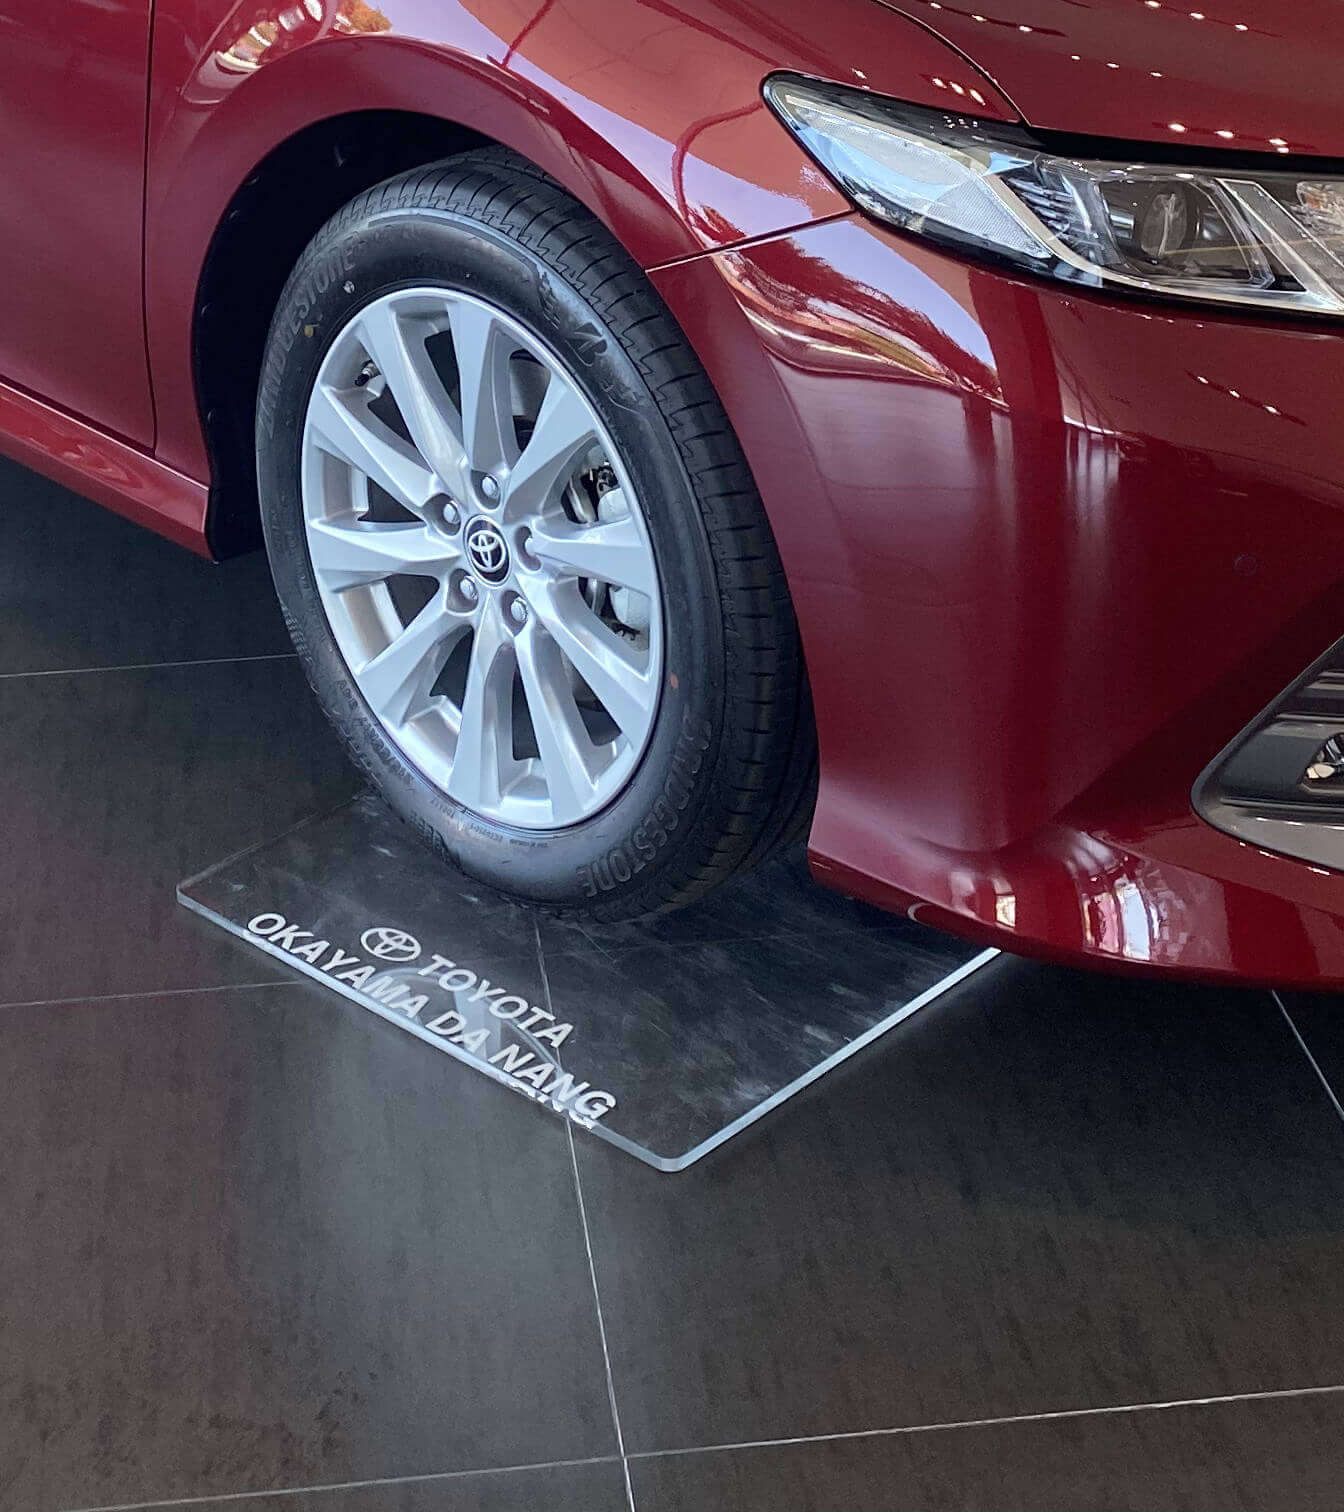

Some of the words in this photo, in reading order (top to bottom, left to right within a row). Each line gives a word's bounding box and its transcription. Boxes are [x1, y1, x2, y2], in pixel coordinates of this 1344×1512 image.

[247, 913, 429, 1019] OKAYAMA
[425, 1010, 490, 1053] DA
[488, 1043, 616, 1120] NANG
[418, 954, 575, 1048] TOYOTA
